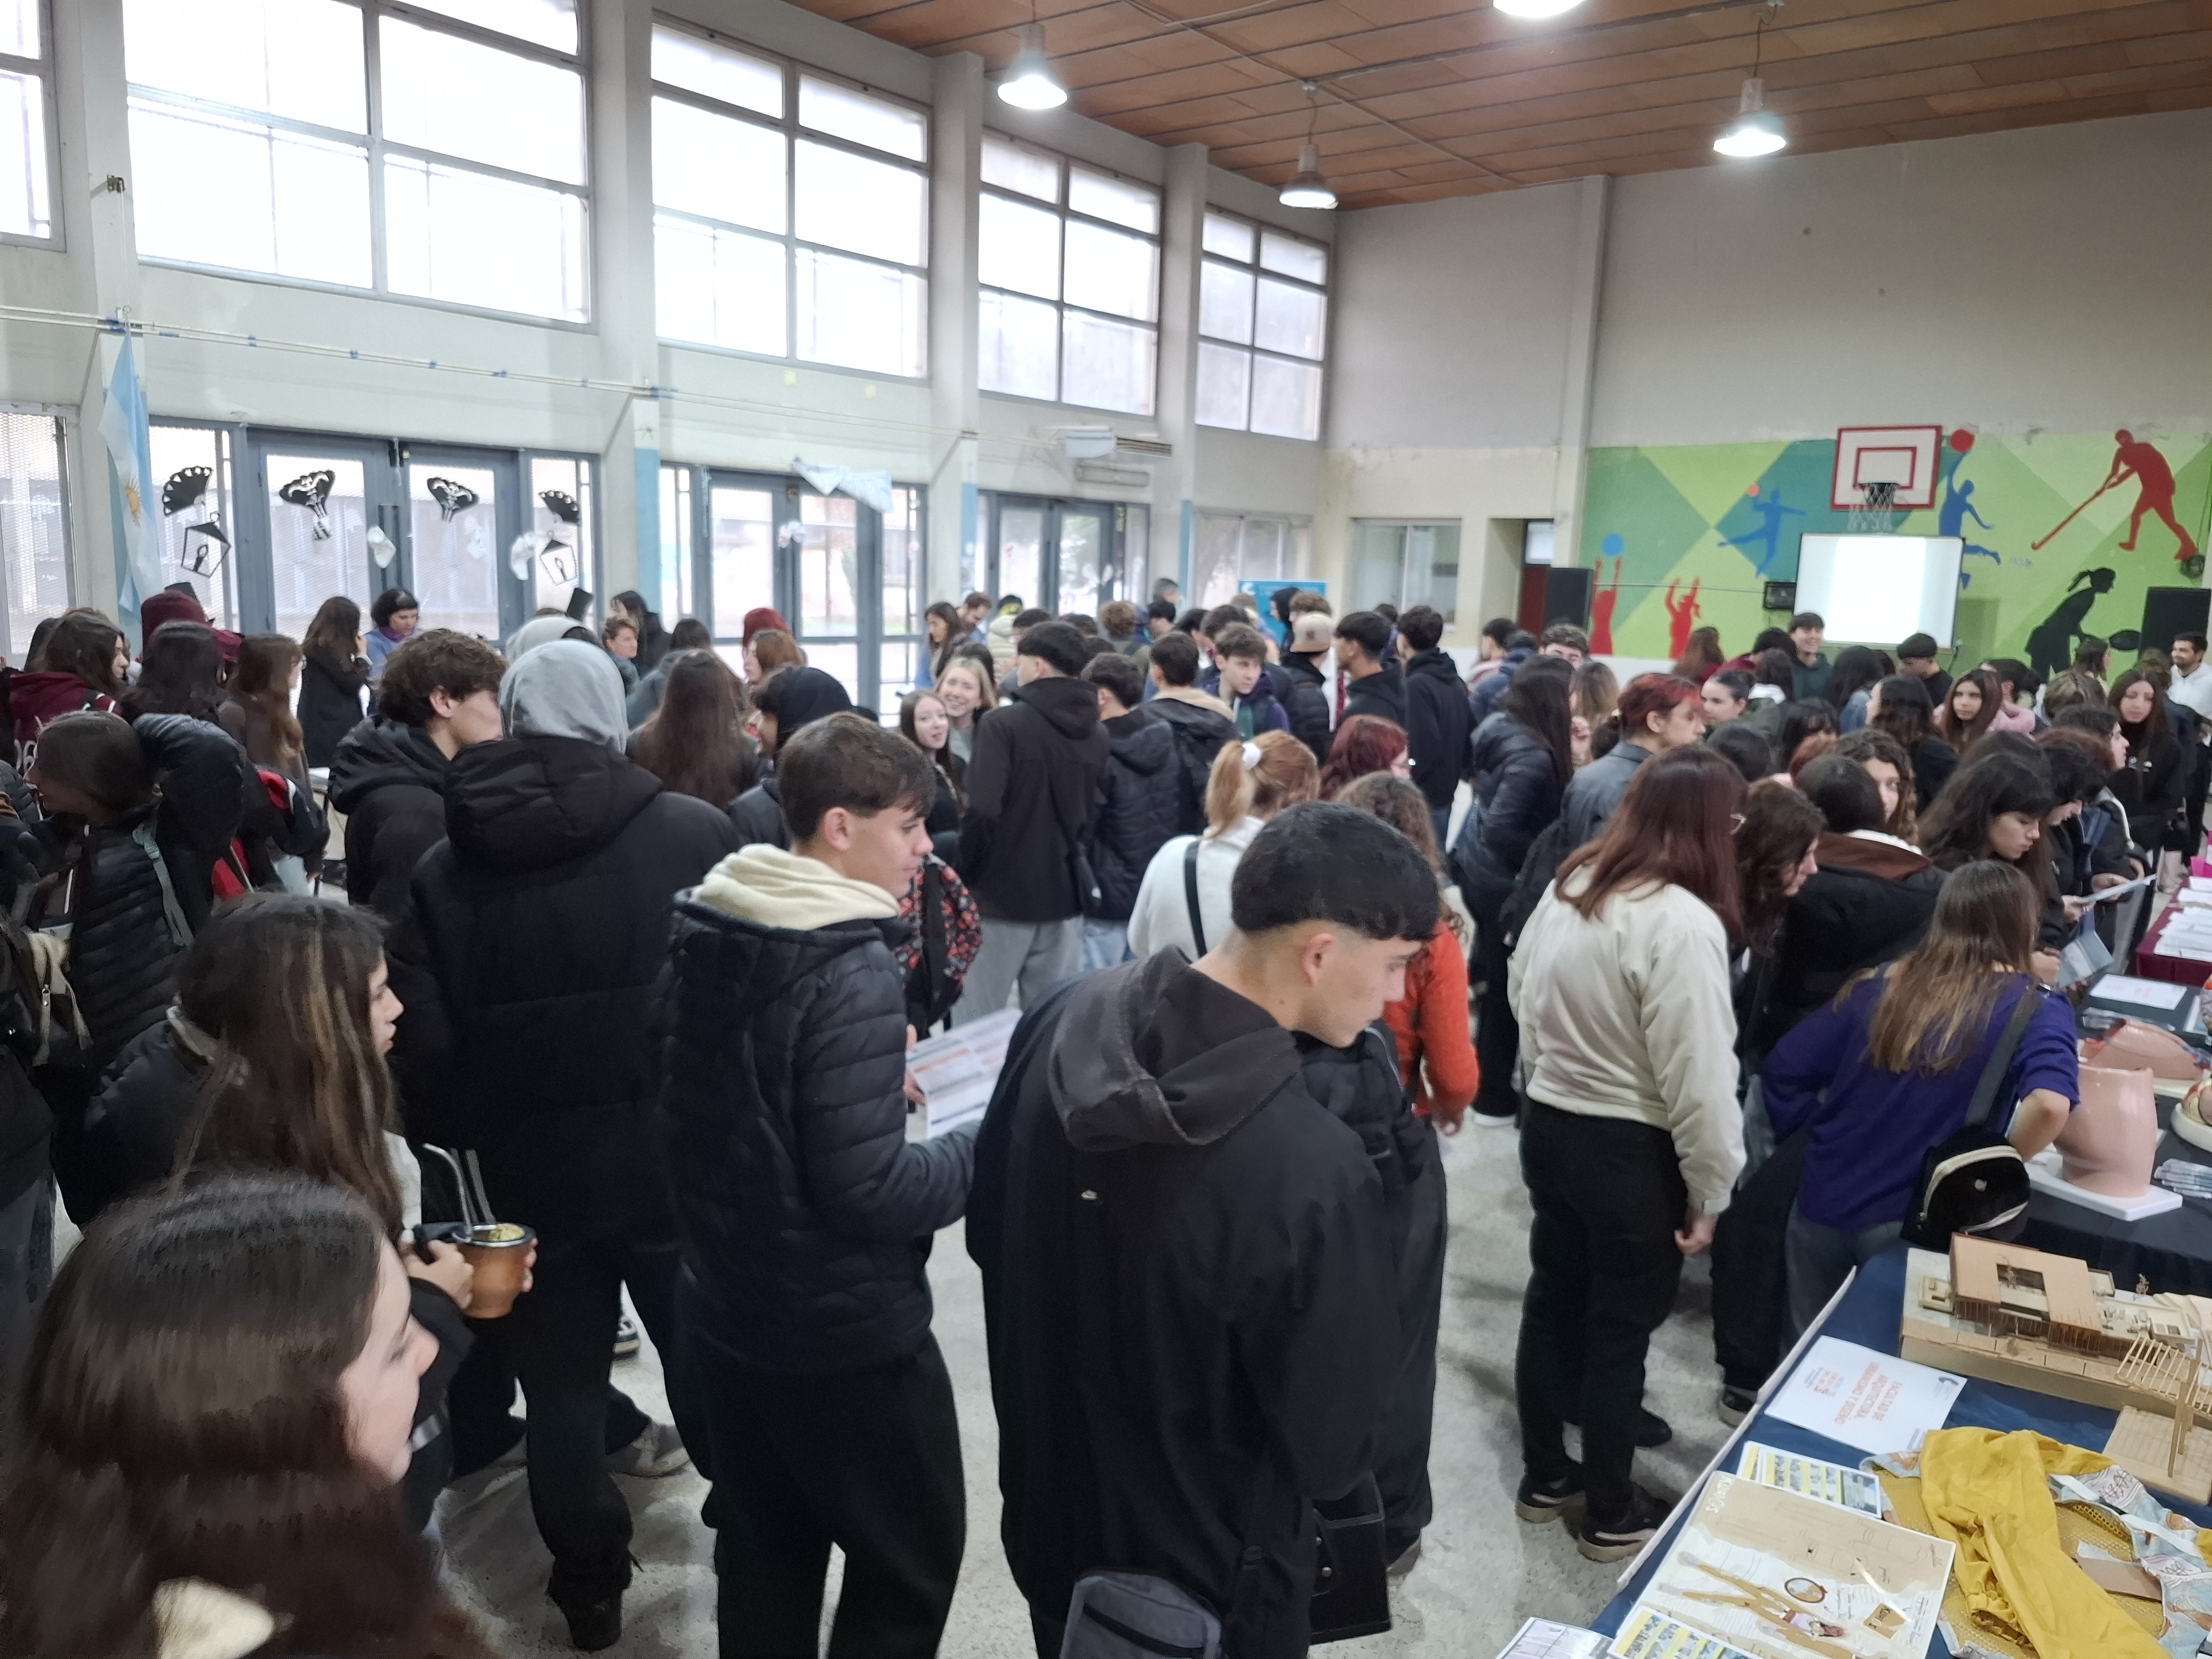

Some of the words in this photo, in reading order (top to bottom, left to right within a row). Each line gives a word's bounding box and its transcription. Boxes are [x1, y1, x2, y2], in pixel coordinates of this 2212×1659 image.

[1852, 1362, 1880, 1396] URBANISMO
[1878, 1382, 1902, 1412] FACULTAD
[1872, 1412, 1886, 1422] DE
